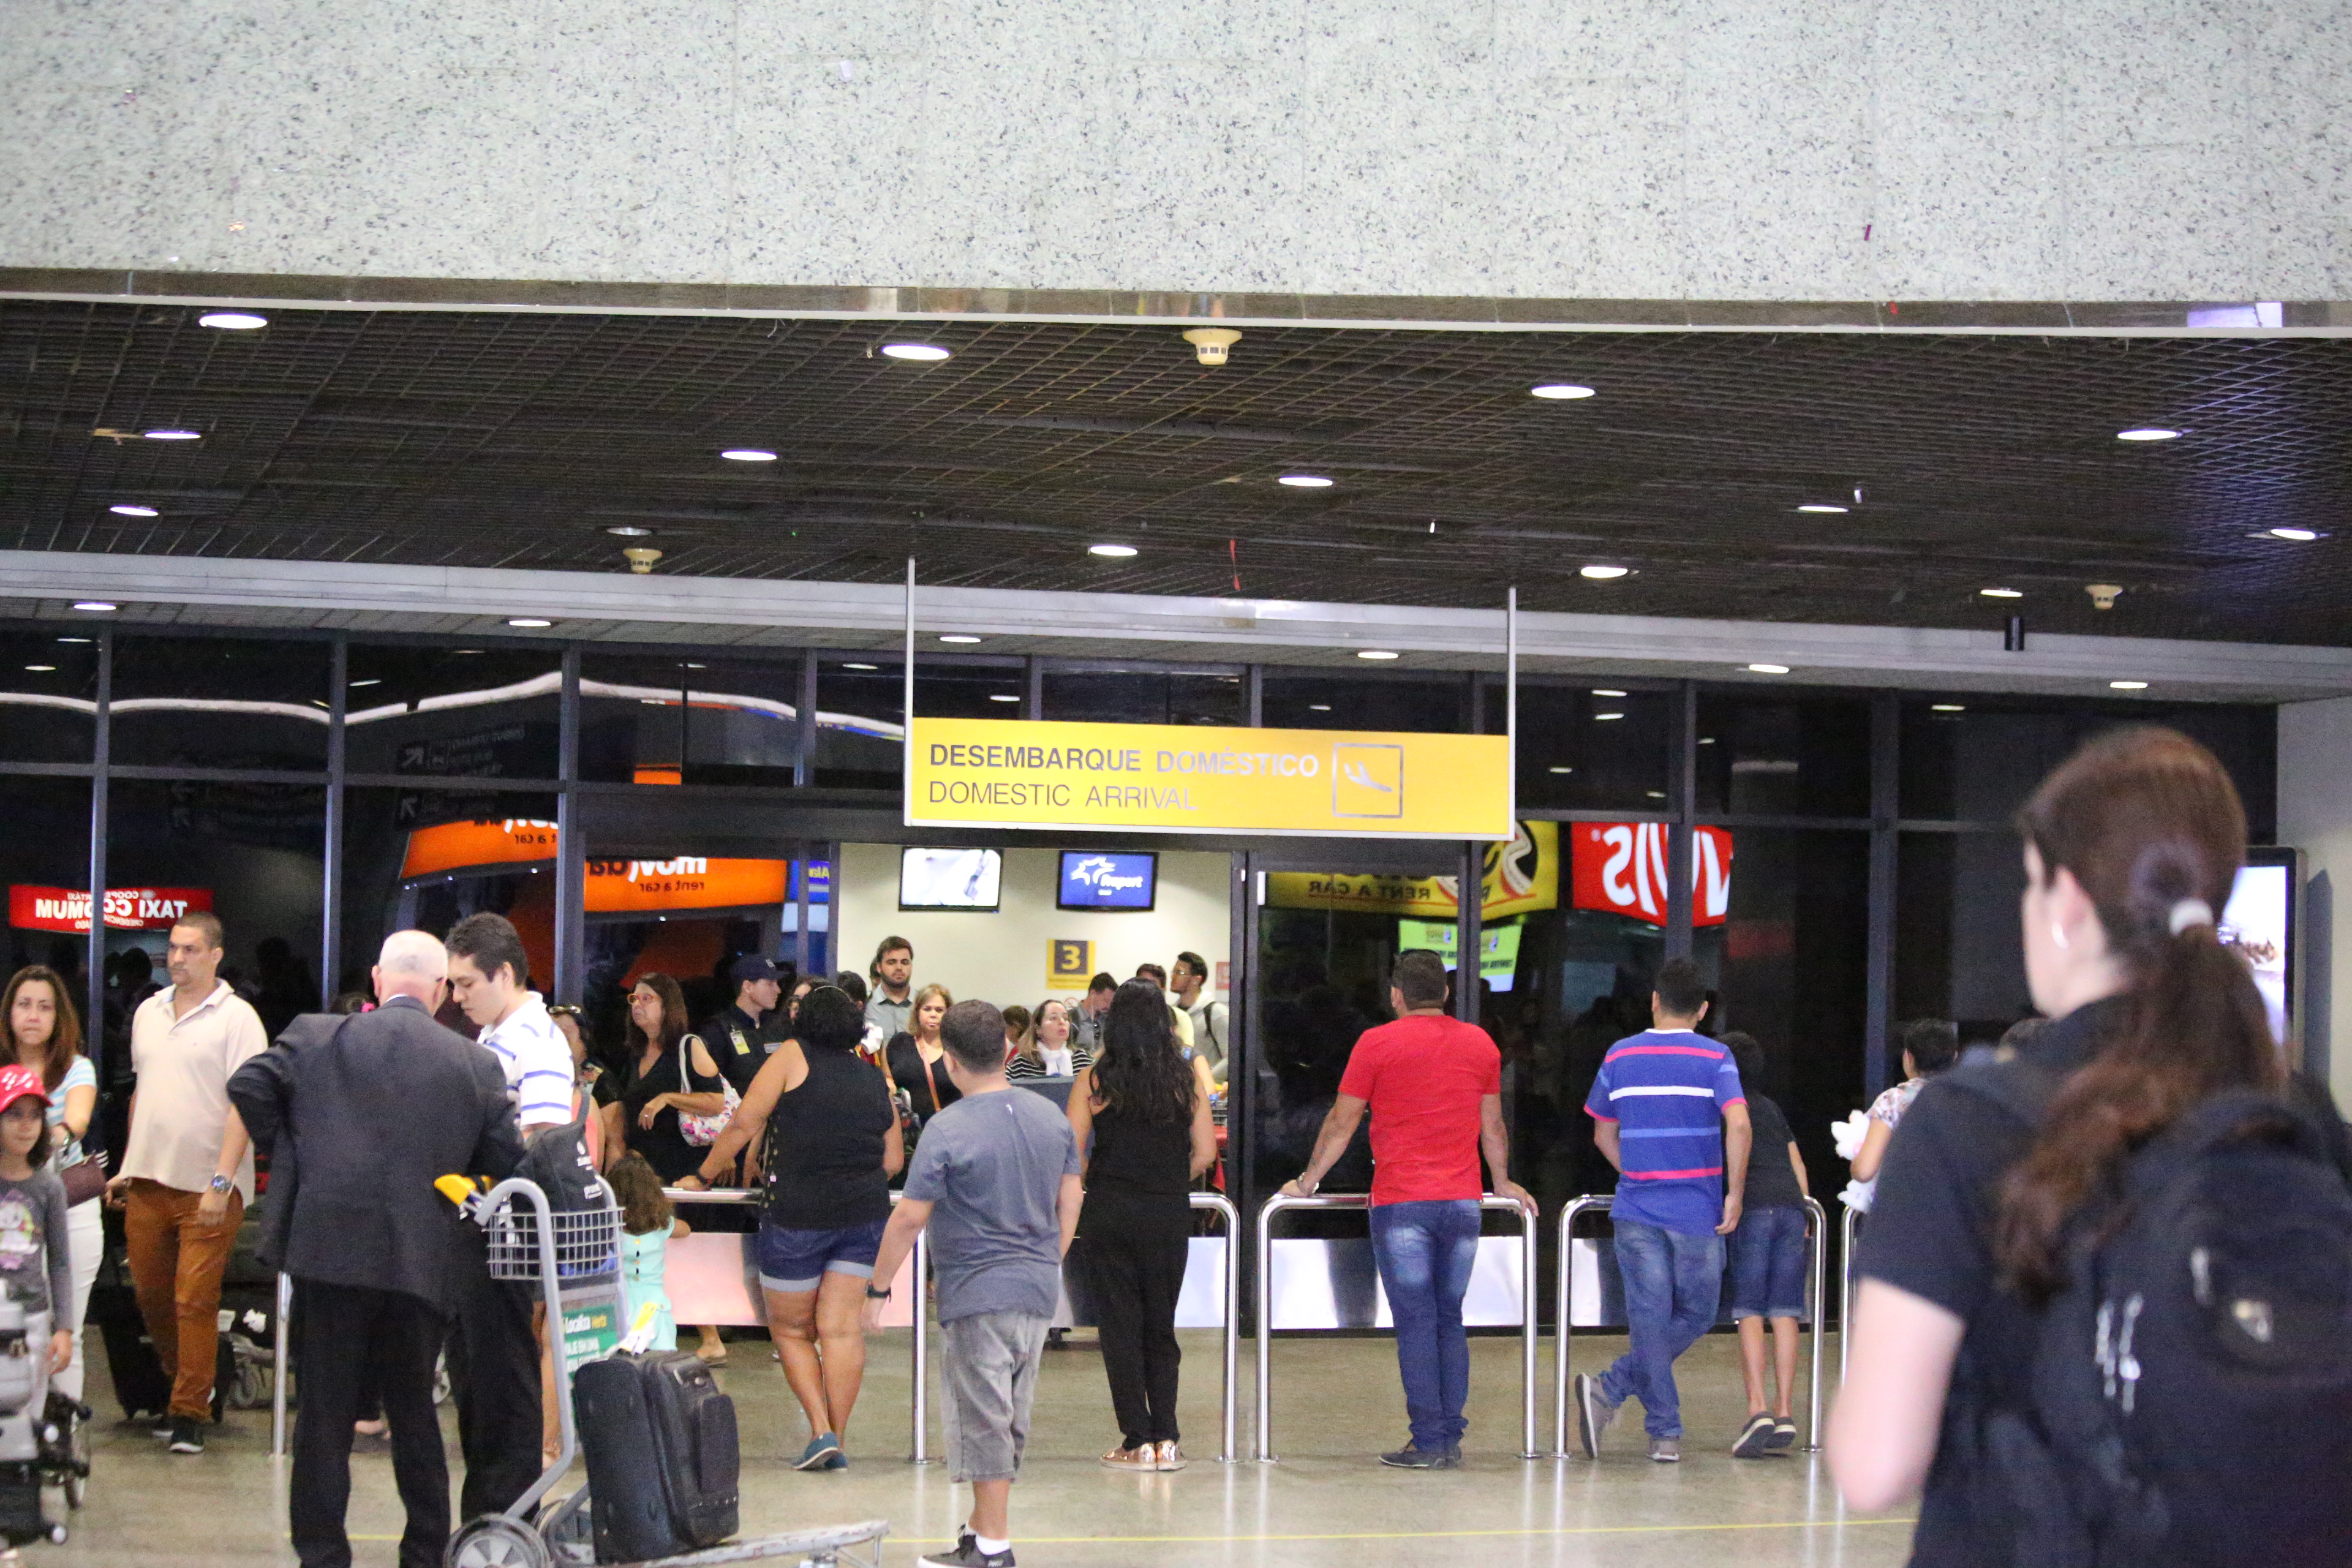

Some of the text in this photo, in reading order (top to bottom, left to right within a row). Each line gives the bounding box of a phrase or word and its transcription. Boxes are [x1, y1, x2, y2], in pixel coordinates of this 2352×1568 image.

[930, 744, 1319, 777] DESEMBARQUE DOMÉSTICO
[929, 781, 1198, 810] DOMESTIC ARRIVAL
[1061, 944, 1080, 970] 3
